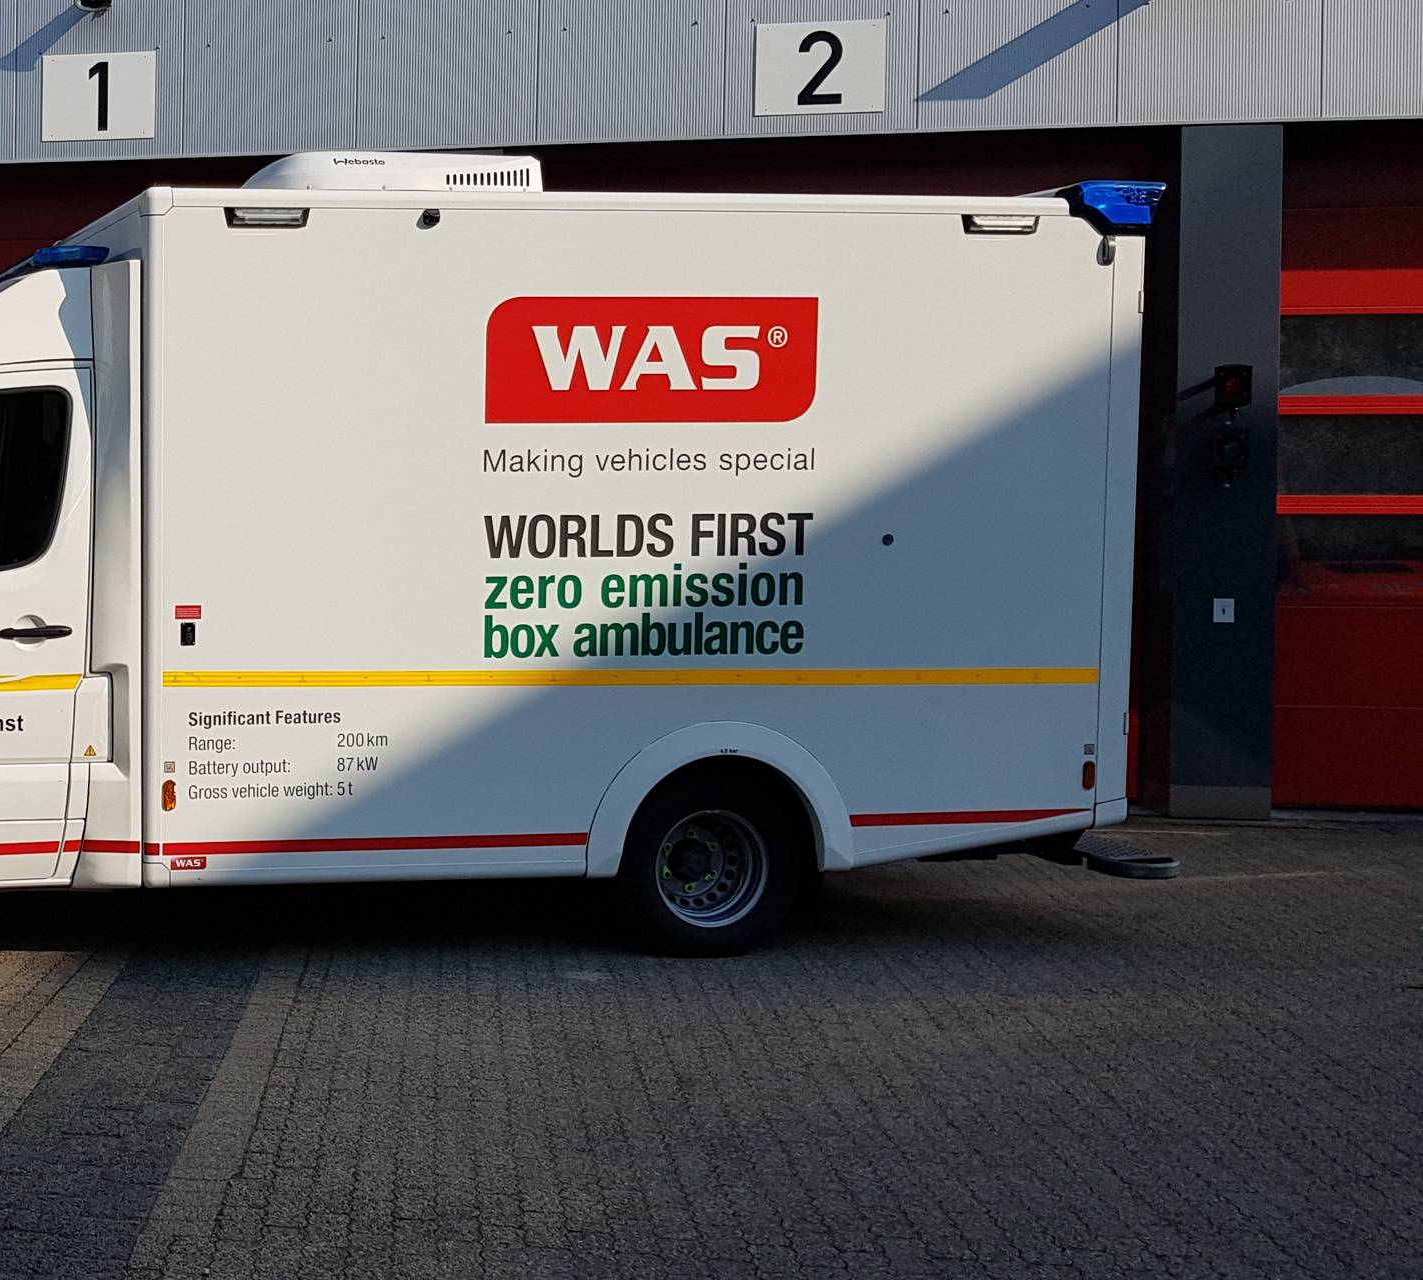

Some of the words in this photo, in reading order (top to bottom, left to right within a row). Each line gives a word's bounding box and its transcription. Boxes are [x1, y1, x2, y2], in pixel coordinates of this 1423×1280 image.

[797, 30, 843, 106] 2
[88, 61, 109, 131] 1
[333, 157, 385, 166] Webasto
[483, 448, 583, 478] Making
[595, 448, 707, 472] vehicles
[719, 447, 815, 476] special
[484, 513, 675, 559] WORLDS
[691, 512, 813, 557] FIRST
[484, 573, 582, 610] zero
[601, 562, 804, 608] emission
[484, 614, 560, 659] box
[573, 612, 805, 657] ambulance
[188, 711, 271, 729] Significant
[275, 710, 341, 725] Features
[188, 736, 236, 754] Range:
[337, 733, 365, 748] 200
[367, 732, 388, 747] km
[188, 761, 239, 778] Battery
[242, 759, 291, 776] output:
[336, 757, 354, 772] 87
[357, 756, 378, 771] kW
[188, 784, 228, 800] Gross
[232, 783, 279, 798] vehicle
[283, 782, 333, 800] weight:
[336, 781, 345, 796] 5
[348, 782, 353, 796] t
[176, 859, 202, 868] WAS
